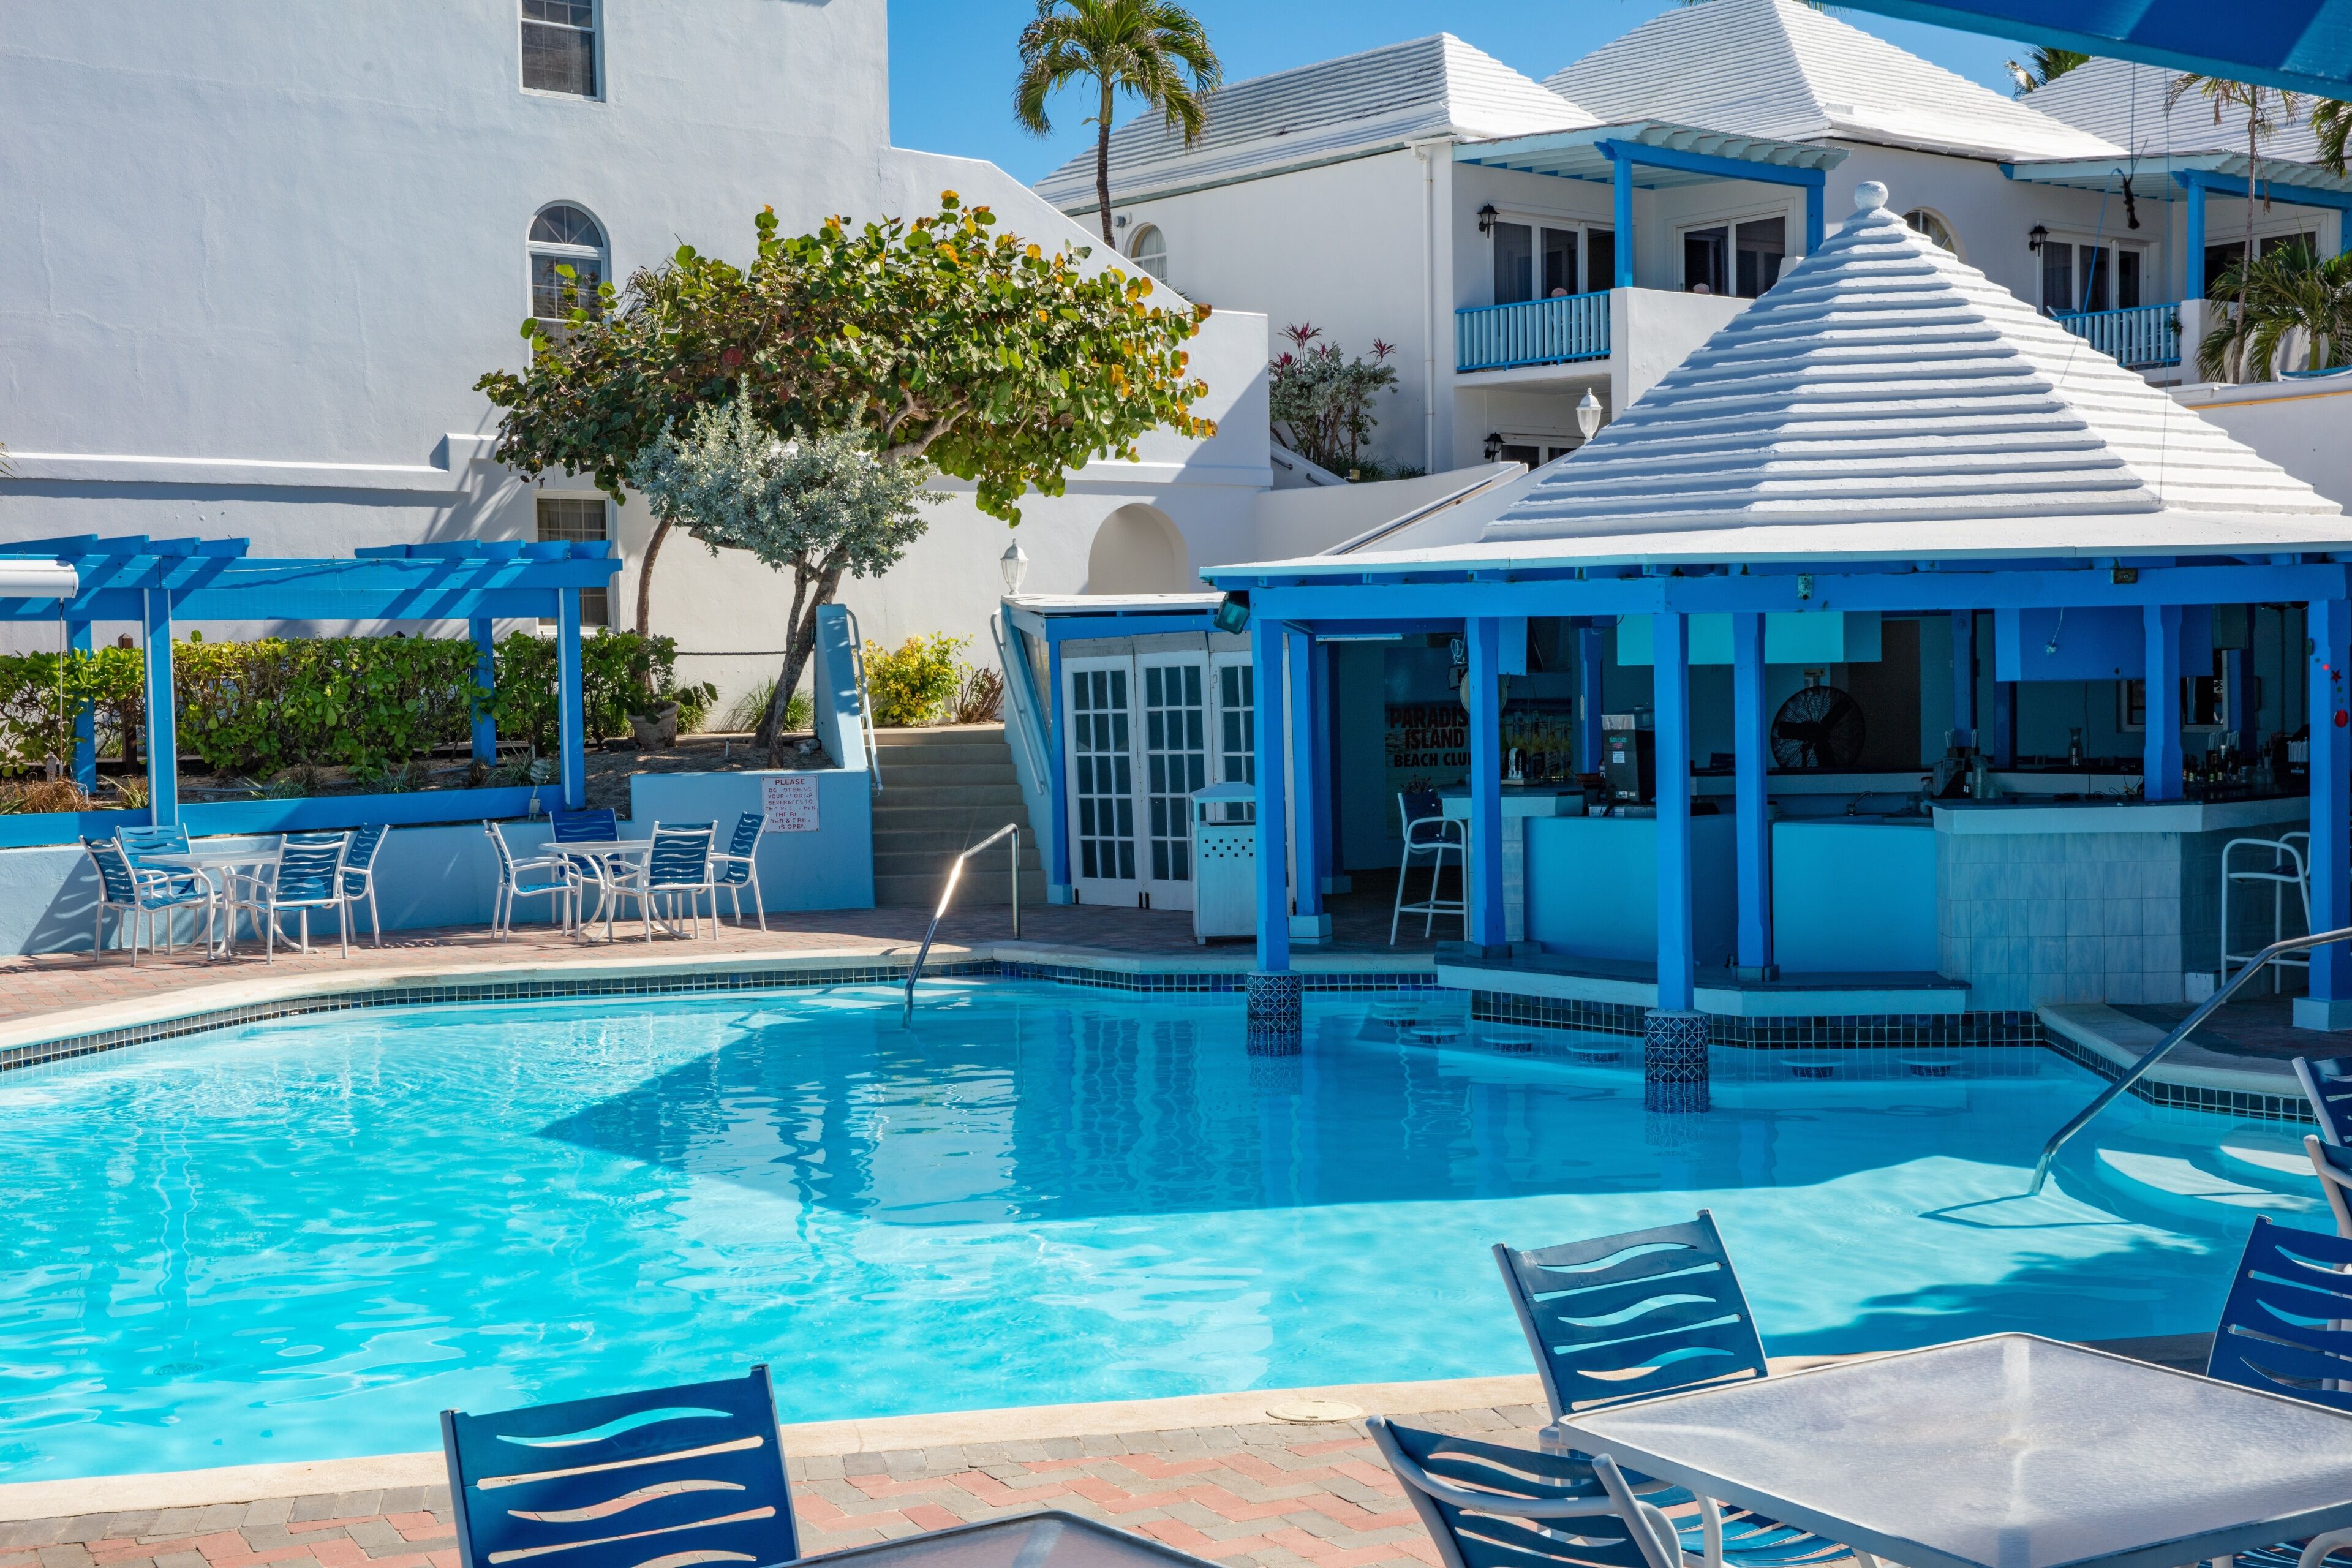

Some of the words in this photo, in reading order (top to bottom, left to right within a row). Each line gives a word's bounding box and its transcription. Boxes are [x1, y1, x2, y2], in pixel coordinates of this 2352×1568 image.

[1390, 706, 1469, 728] PARADIS
[1405, 728, 1464, 749] ISLAND
[1394, 753, 1438, 767] BEACH
